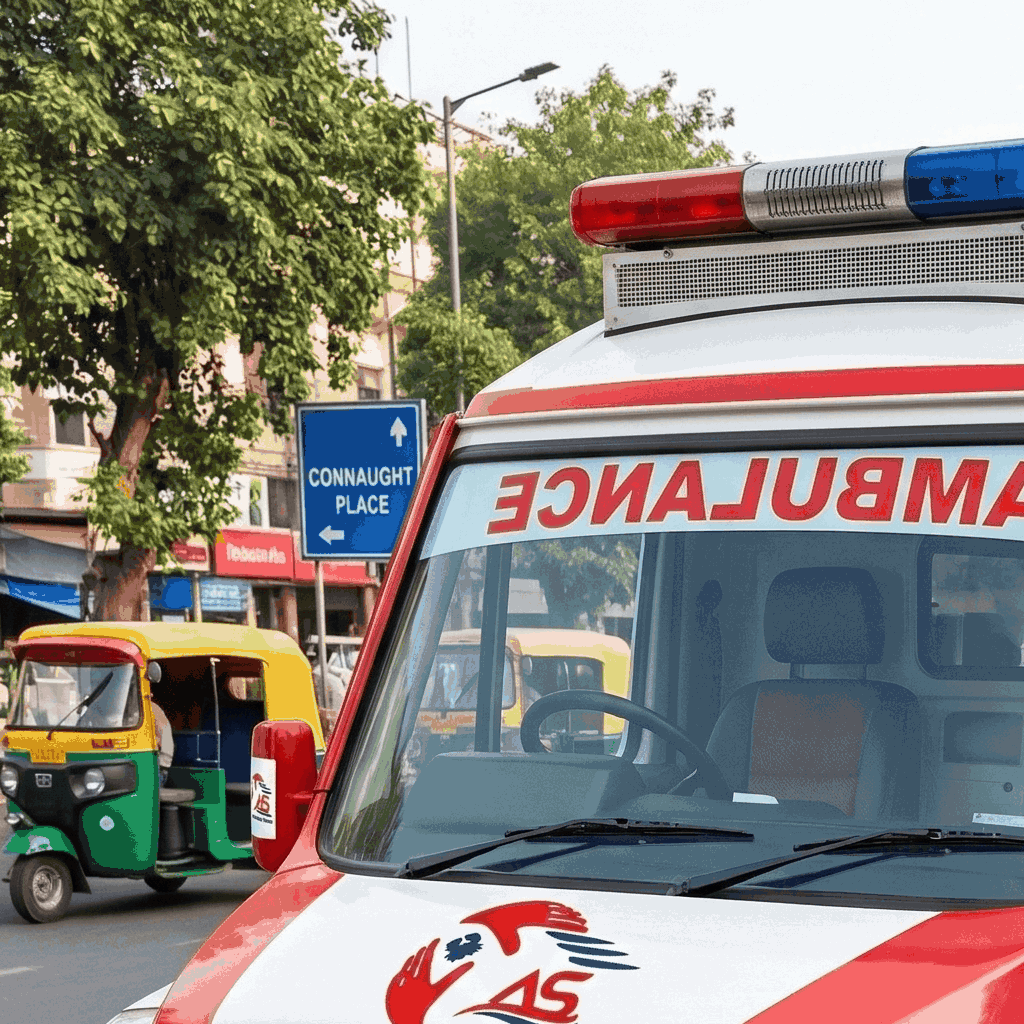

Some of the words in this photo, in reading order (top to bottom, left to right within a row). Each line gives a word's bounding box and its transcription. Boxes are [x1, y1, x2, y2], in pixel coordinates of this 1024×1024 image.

[308, 466, 413, 487] CONNAUGHT
[335, 494, 390, 515] PLACE
[452, 969, 595, 1024] AS
